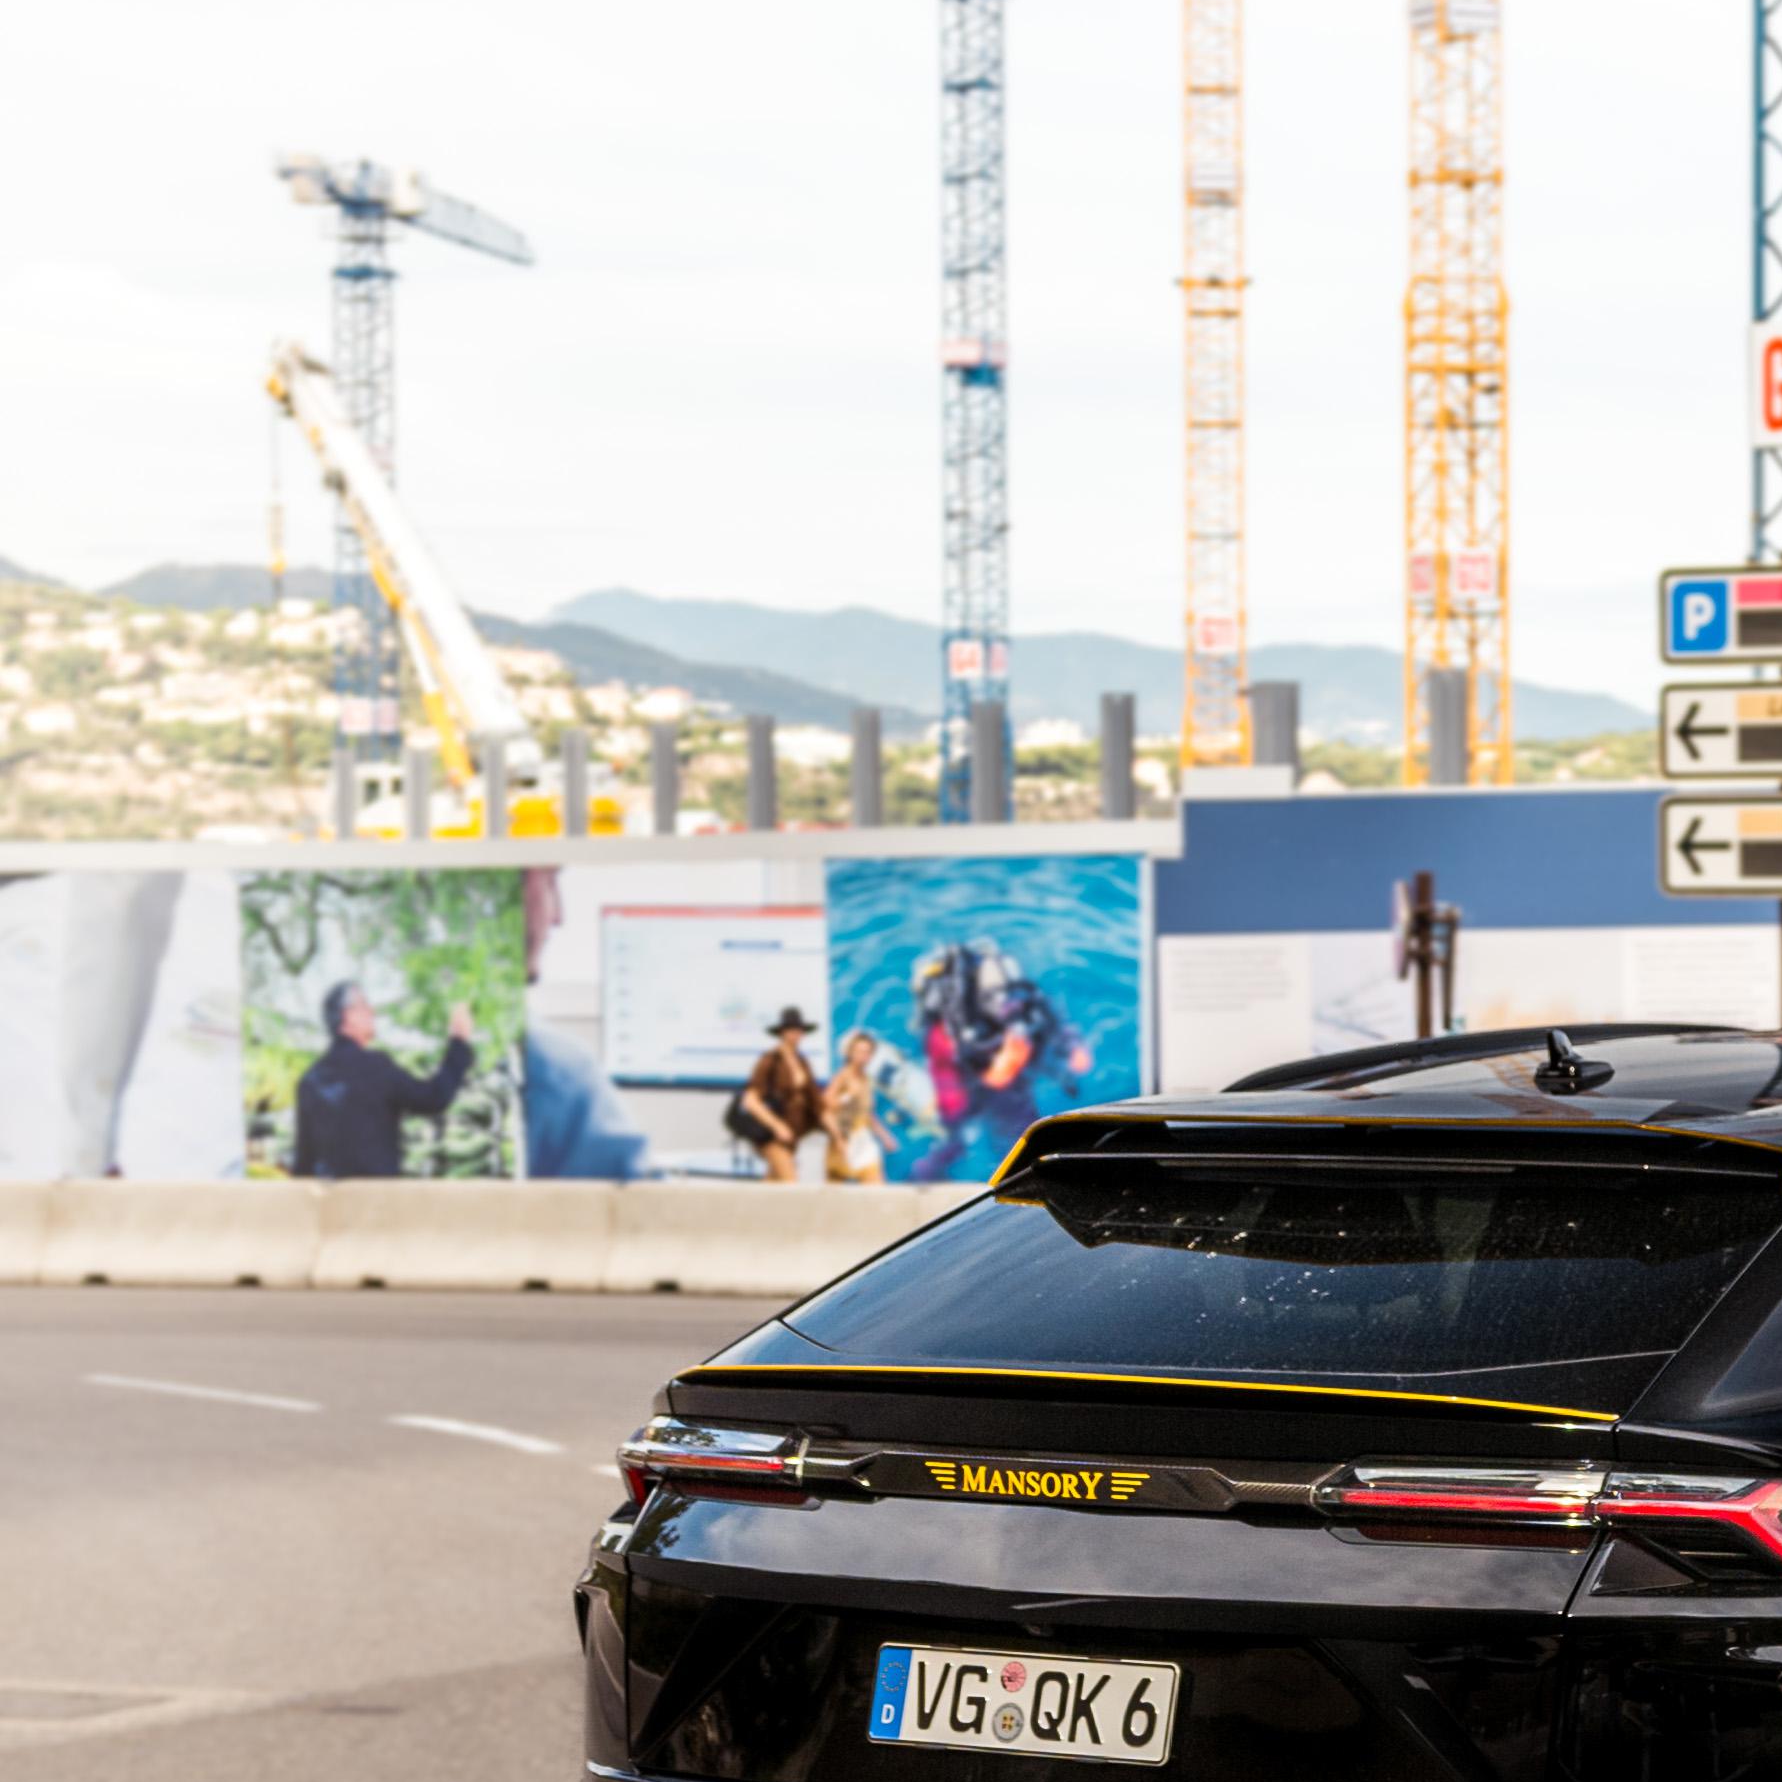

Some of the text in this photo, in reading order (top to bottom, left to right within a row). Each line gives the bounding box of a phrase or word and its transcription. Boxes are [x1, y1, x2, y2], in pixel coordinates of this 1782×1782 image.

[1683, 592, 1717, 641] P
[880, 1704, 896, 1725] D
[917, 1660, 1159, 1749] VG QK 6
